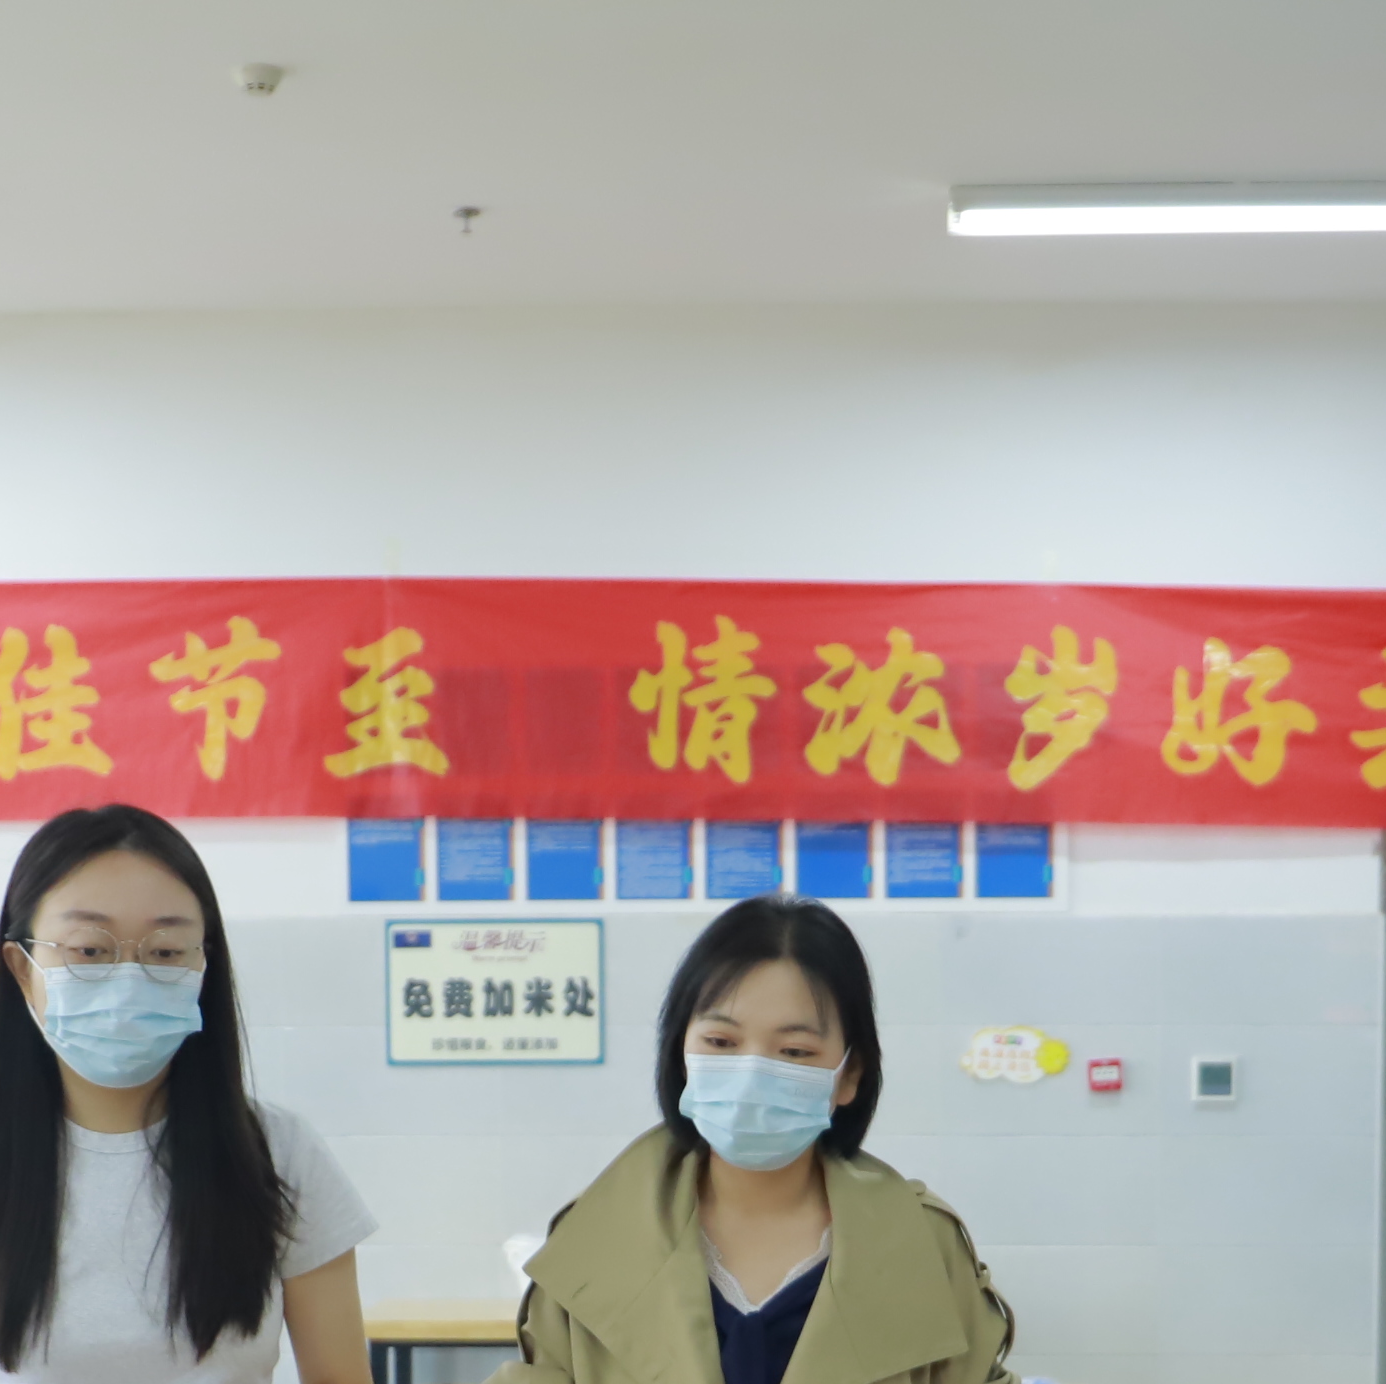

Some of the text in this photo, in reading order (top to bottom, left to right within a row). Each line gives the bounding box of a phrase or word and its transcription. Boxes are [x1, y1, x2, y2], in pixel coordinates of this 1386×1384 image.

[403, 977, 595, 1019] 免费加米处
